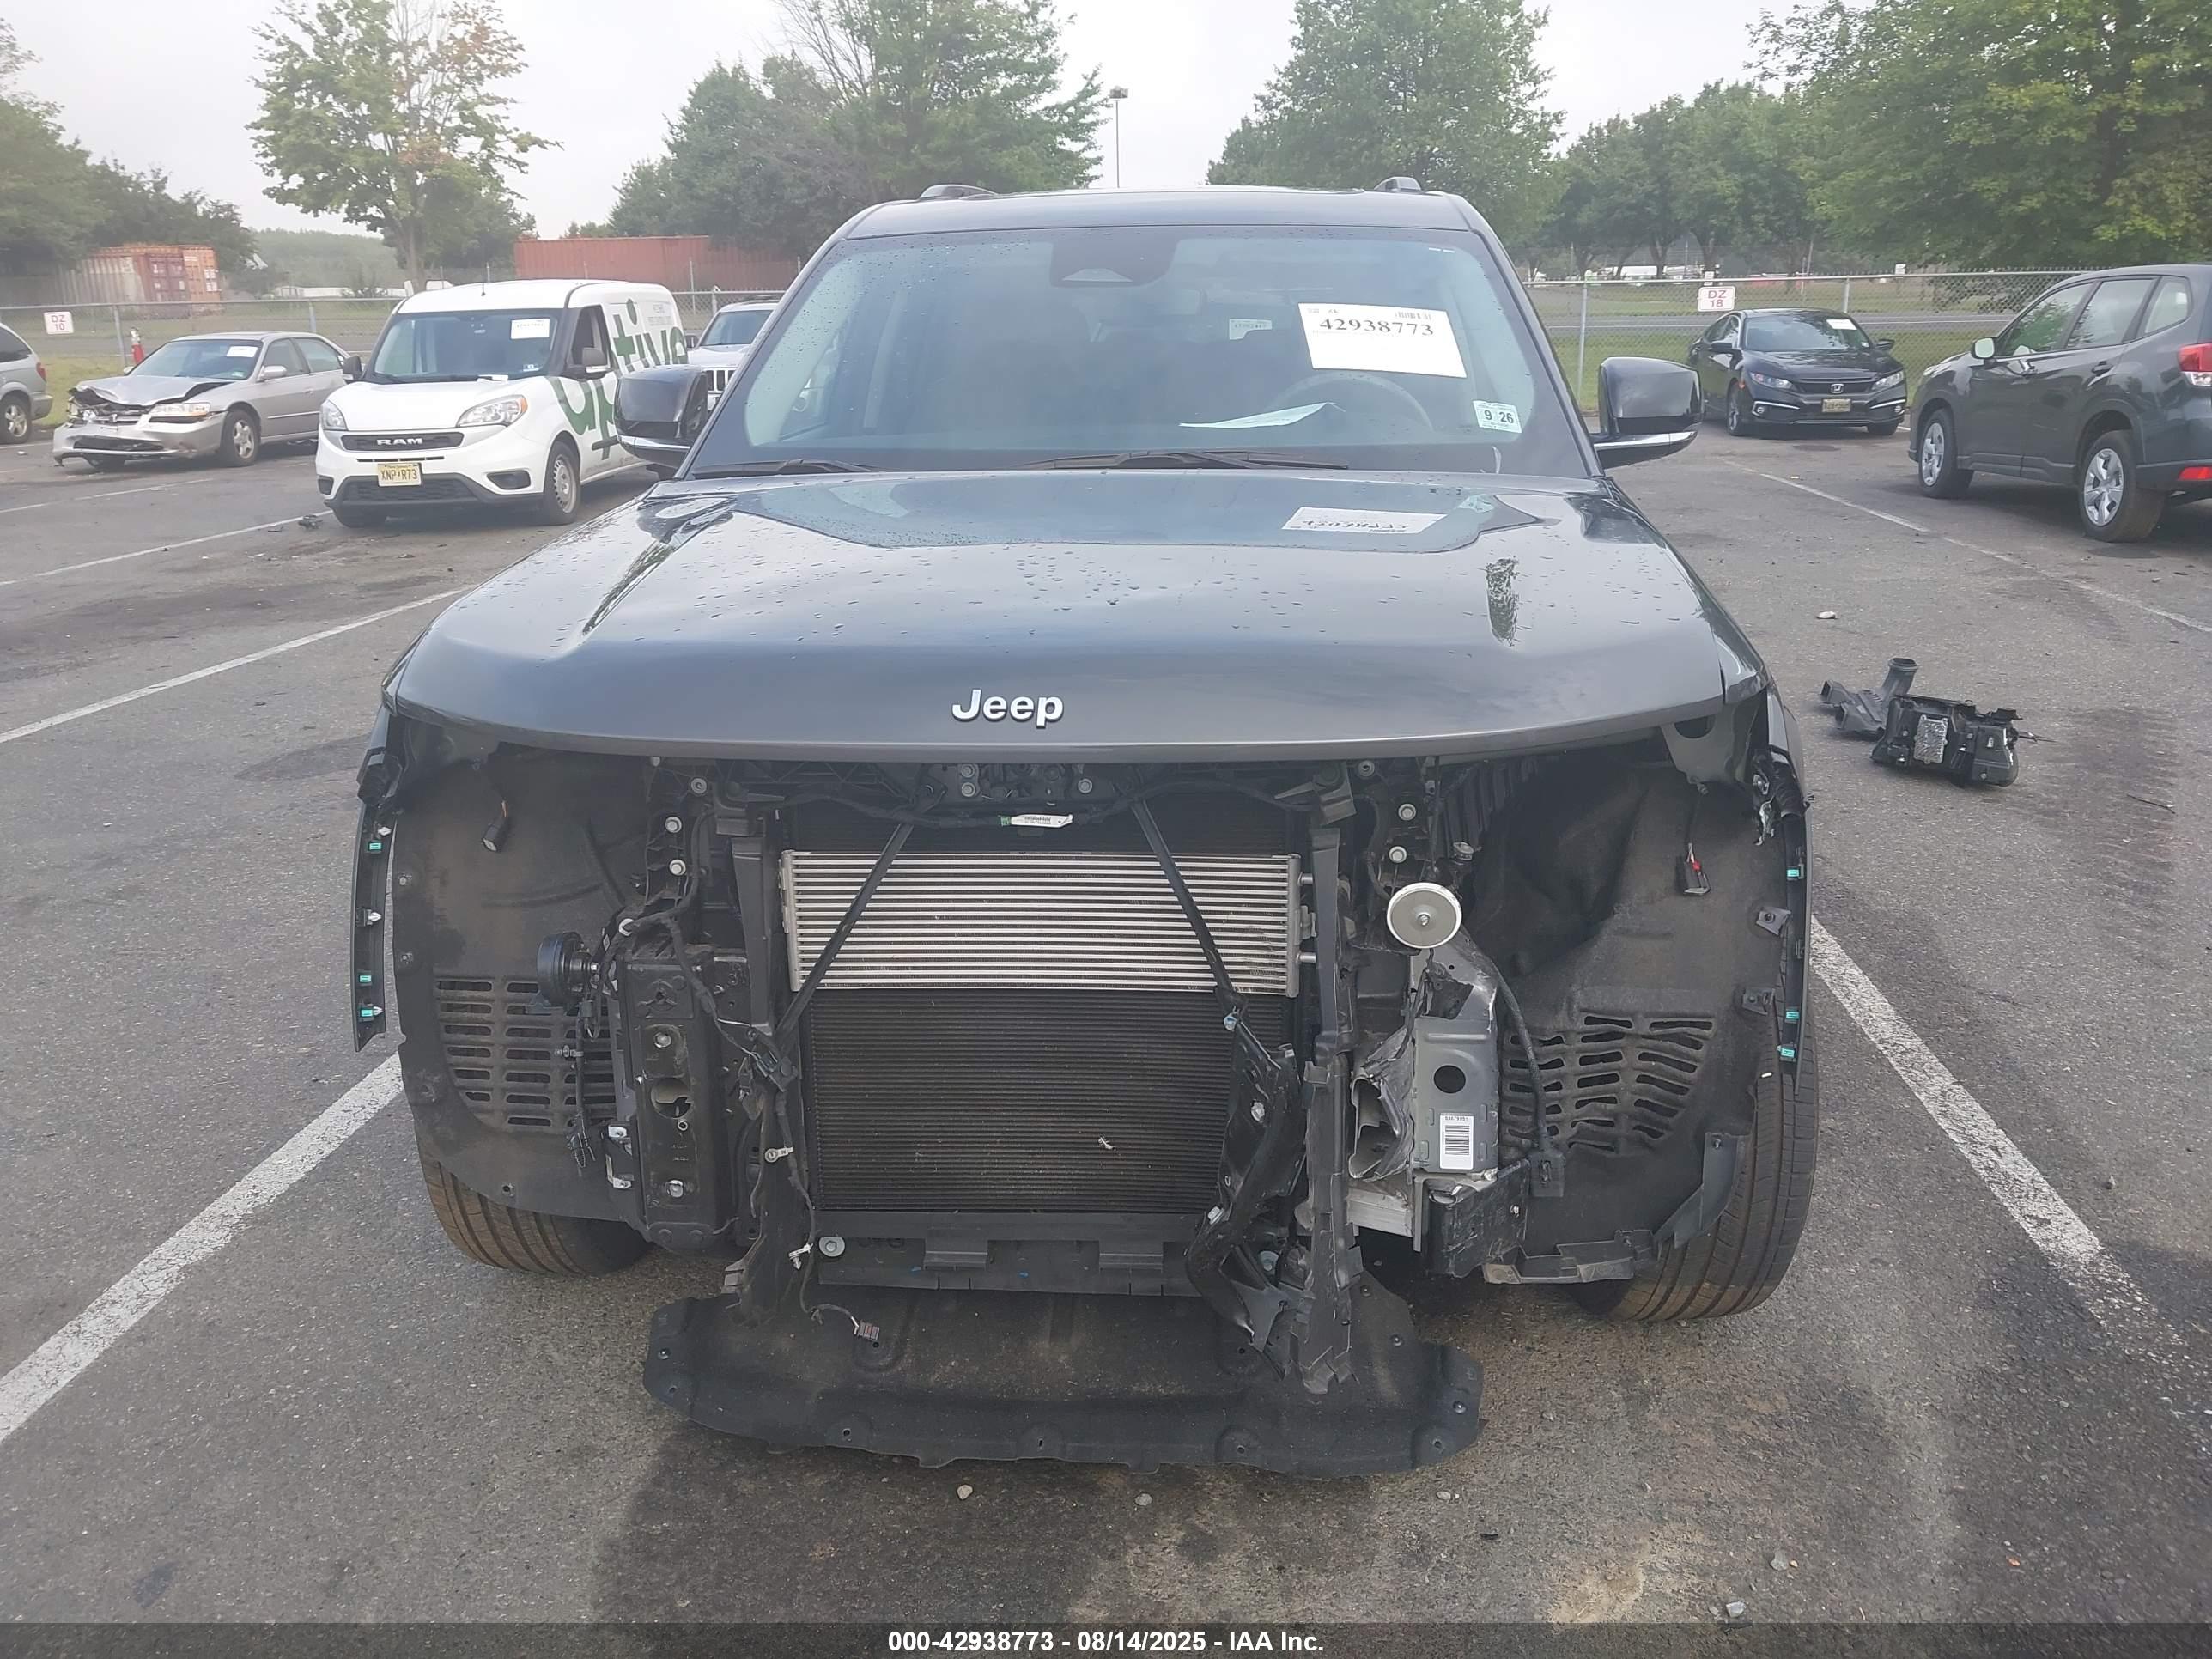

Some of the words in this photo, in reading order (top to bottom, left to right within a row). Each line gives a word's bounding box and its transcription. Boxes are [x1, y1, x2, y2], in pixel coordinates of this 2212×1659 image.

[1708, 289, 1727, 299] DZ
[1710, 299, 1723, 307] 18
[51, 314, 66, 323] DZ
[55, 322, 65, 331] 10
[1319, 318, 1434, 337] 42938773
[1484, 409, 1493, 421] 9
[1498, 411, 1515, 424] 26
[376, 437, 423, 446] RAM
[951, 688, 1065, 729] Jeep
